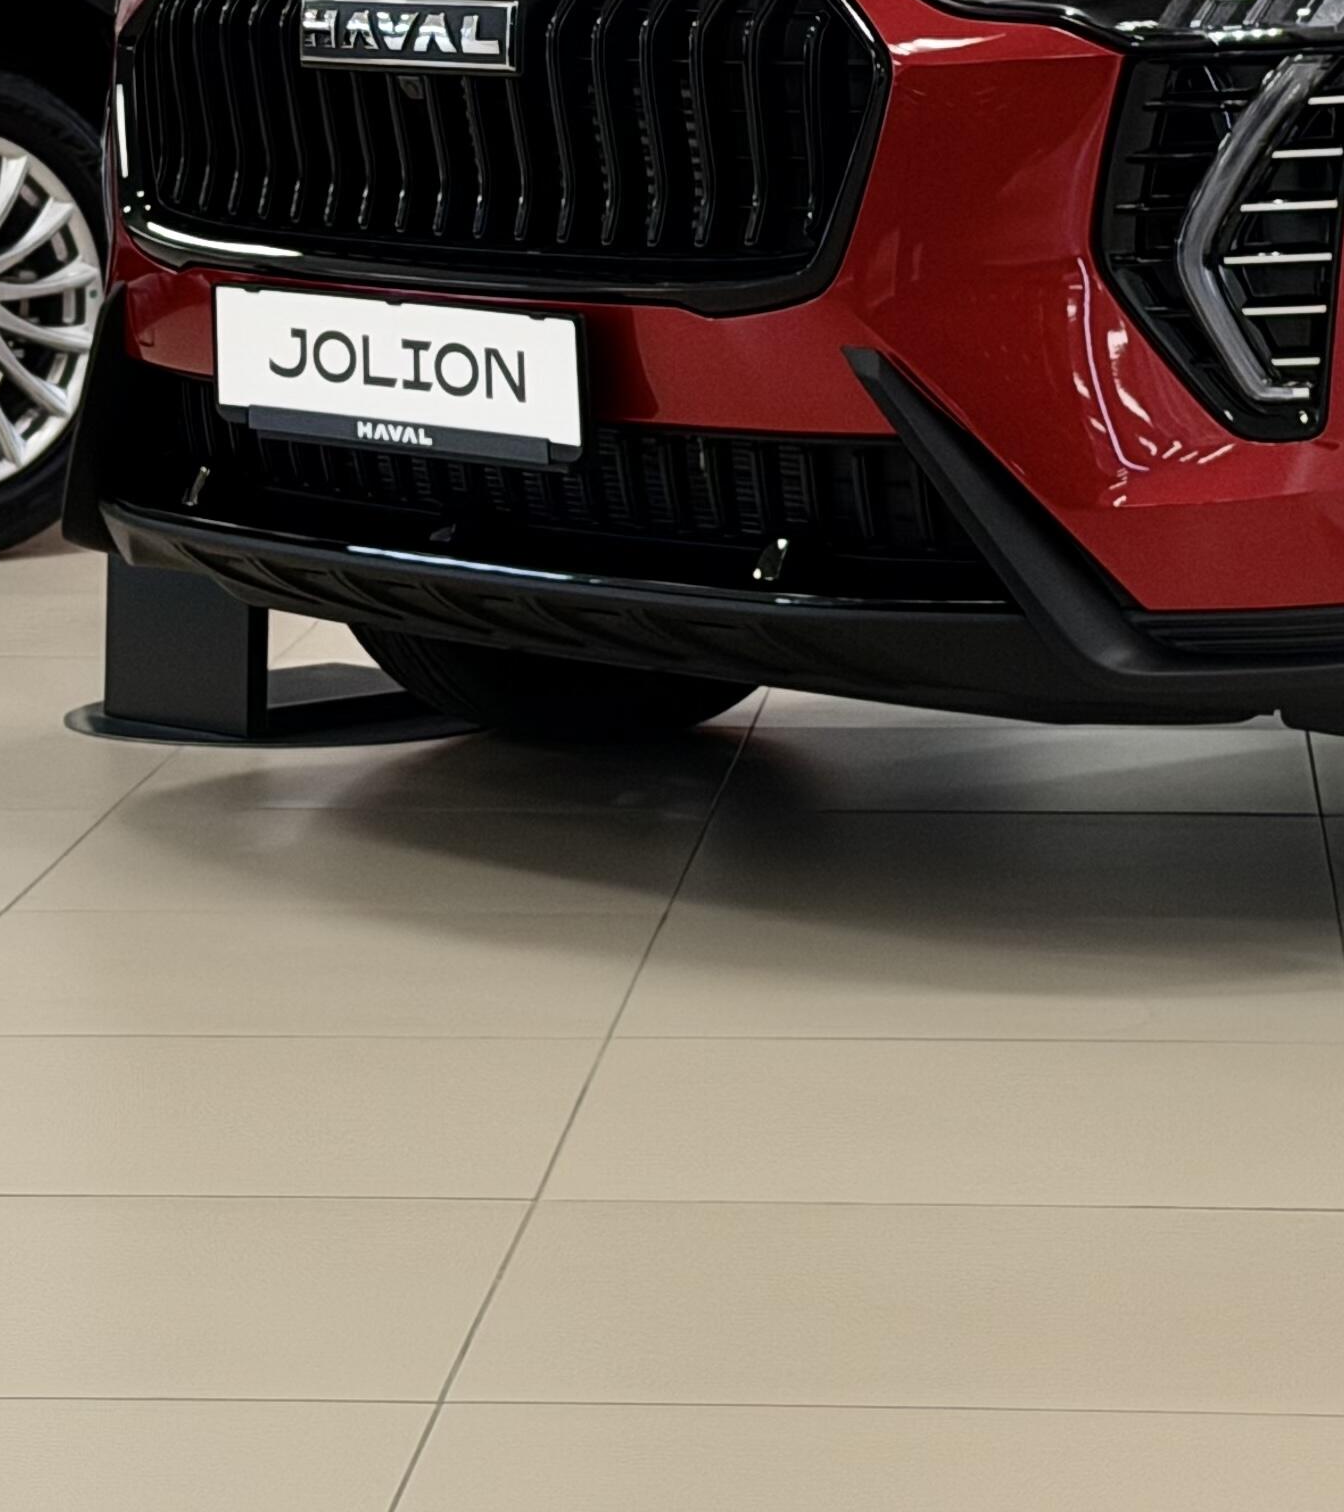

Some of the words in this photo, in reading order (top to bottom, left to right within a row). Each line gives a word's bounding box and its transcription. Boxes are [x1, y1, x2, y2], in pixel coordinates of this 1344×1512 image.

[302, 9, 500, 55] HAVAL
[268, 327, 527, 404] JOLION
[356, 420, 433, 446] HAVAL
